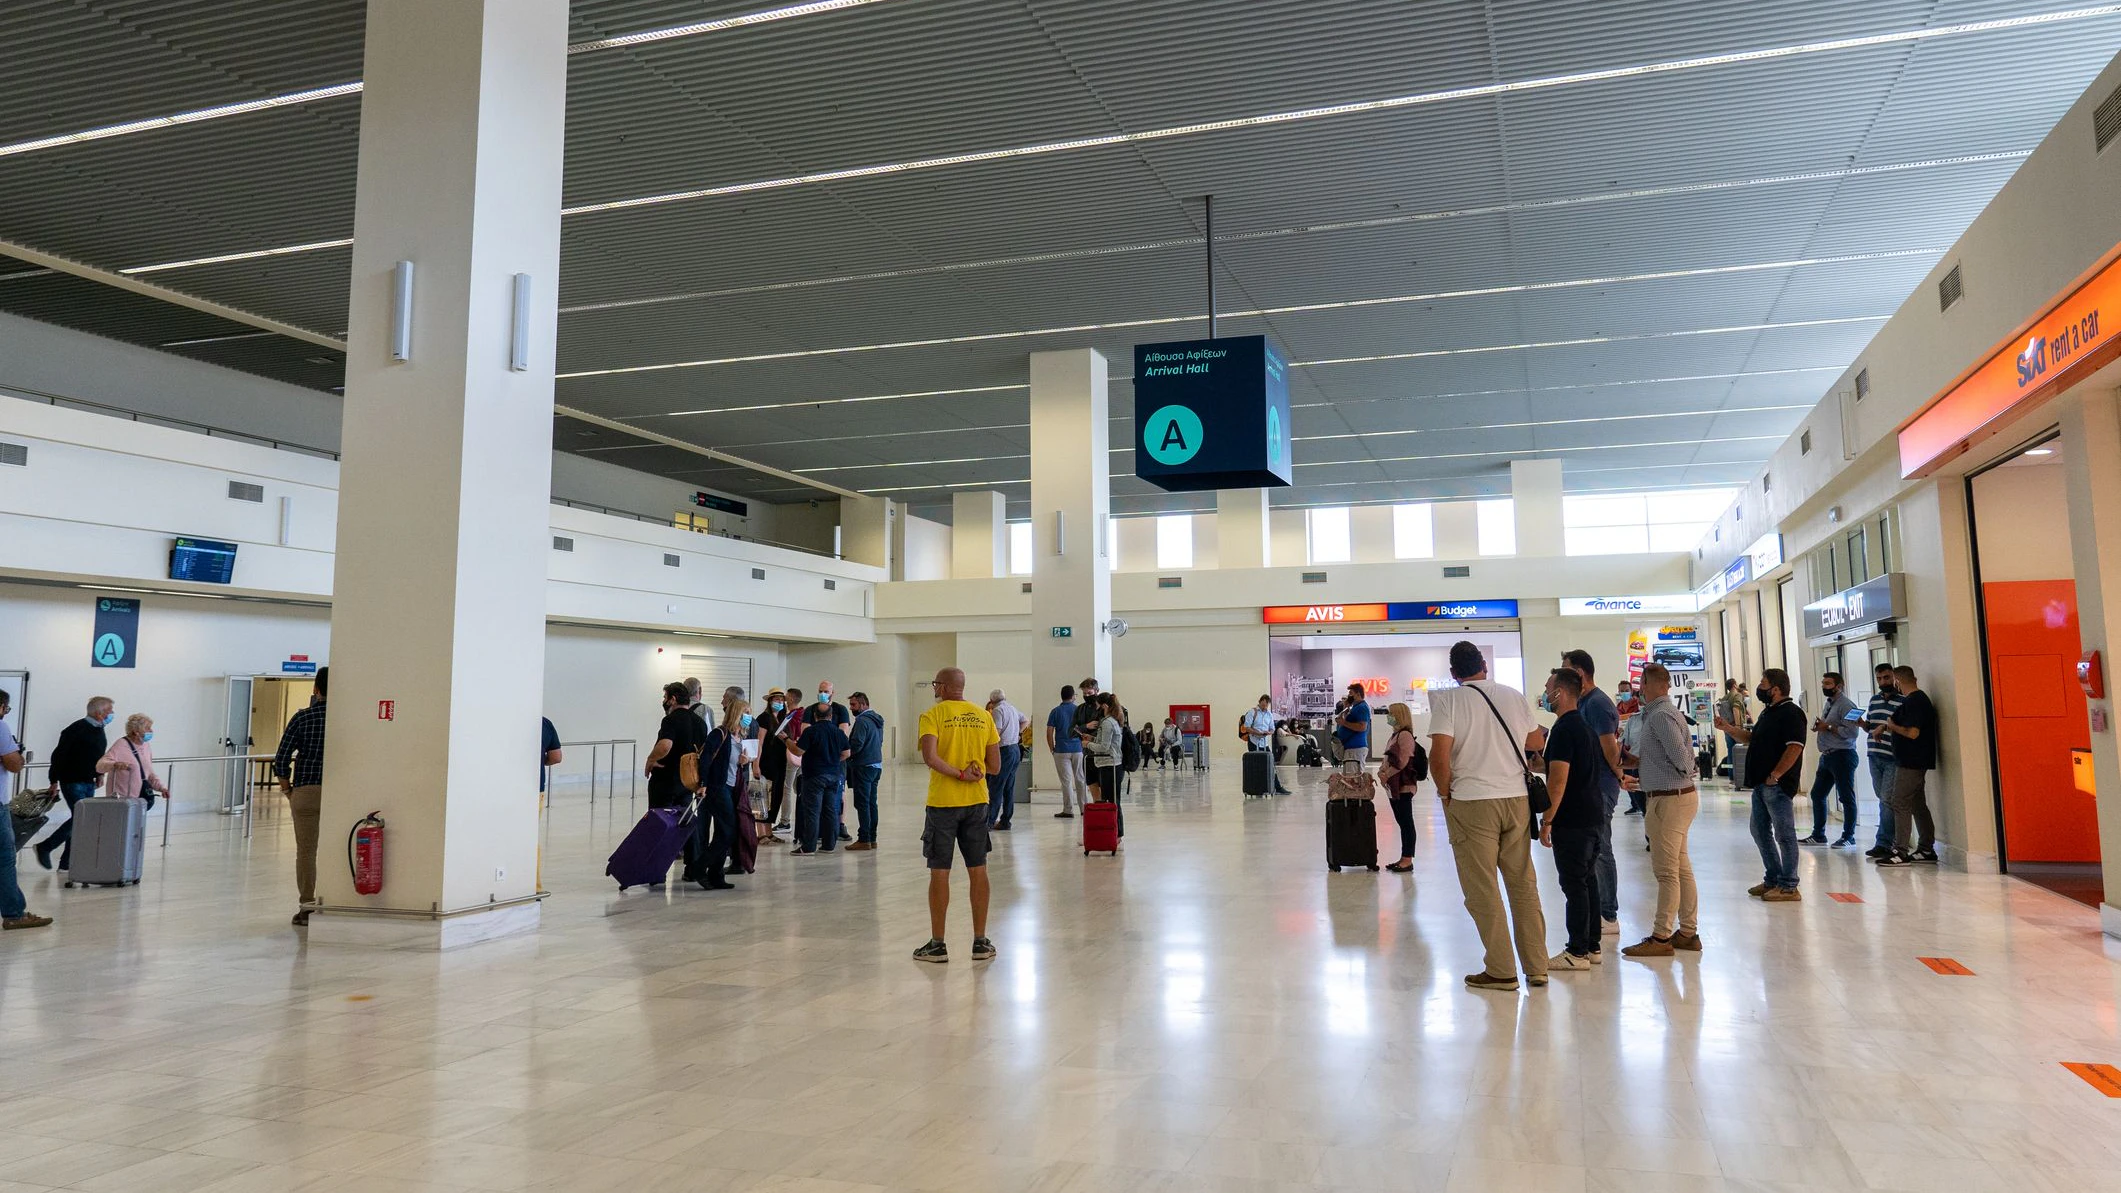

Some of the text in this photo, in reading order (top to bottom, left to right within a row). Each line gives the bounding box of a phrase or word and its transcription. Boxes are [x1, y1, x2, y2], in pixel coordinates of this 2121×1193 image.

[2050, 326, 2071, 365] rent
[2072, 324, 2080, 350] a
[2081, 308, 2099, 343] car
[1144, 349, 1227, 363] Αίθουσα Αφίξεων
[1145, 363, 1209, 377] Arrival Hall
[1160, 419, 1187, 451] A
[1441, 605, 1477, 617] Budget
[1594, 599, 1641, 610] avance
[1848, 592, 1864, 621] EXIT
[1305, 606, 1344, 621] AVIS
[101, 639, 118, 660] A
[1353, 680, 1388, 692] VIS
